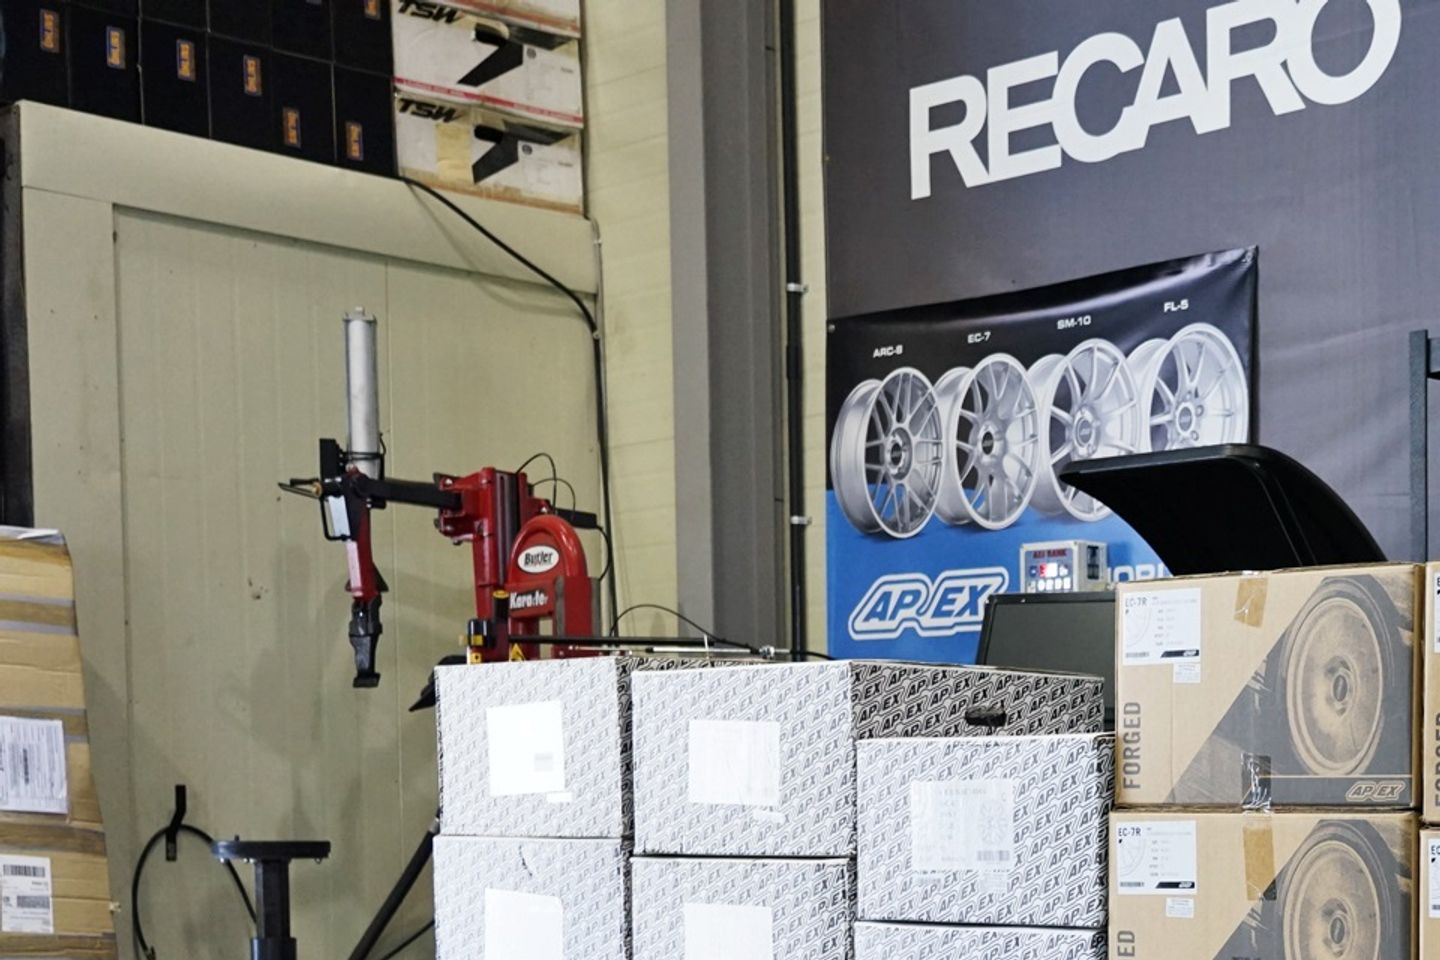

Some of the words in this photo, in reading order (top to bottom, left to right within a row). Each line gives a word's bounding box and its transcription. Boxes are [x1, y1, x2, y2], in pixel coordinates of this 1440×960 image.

[909, 0, 1403, 200] RECARO
[399, 98, 460, 122] TSW
[1163, 299, 1189, 312] FL-5
[1056, 315, 1092, 329] SM-10
[967, 331, 991, 344] EC-7
[872, 344, 903, 358] ARC-8
[525, 551, 553, 567] Butler
[1123, 701, 1141, 790] FORGED
[1118, 827, 1141, 837] EC-7R
